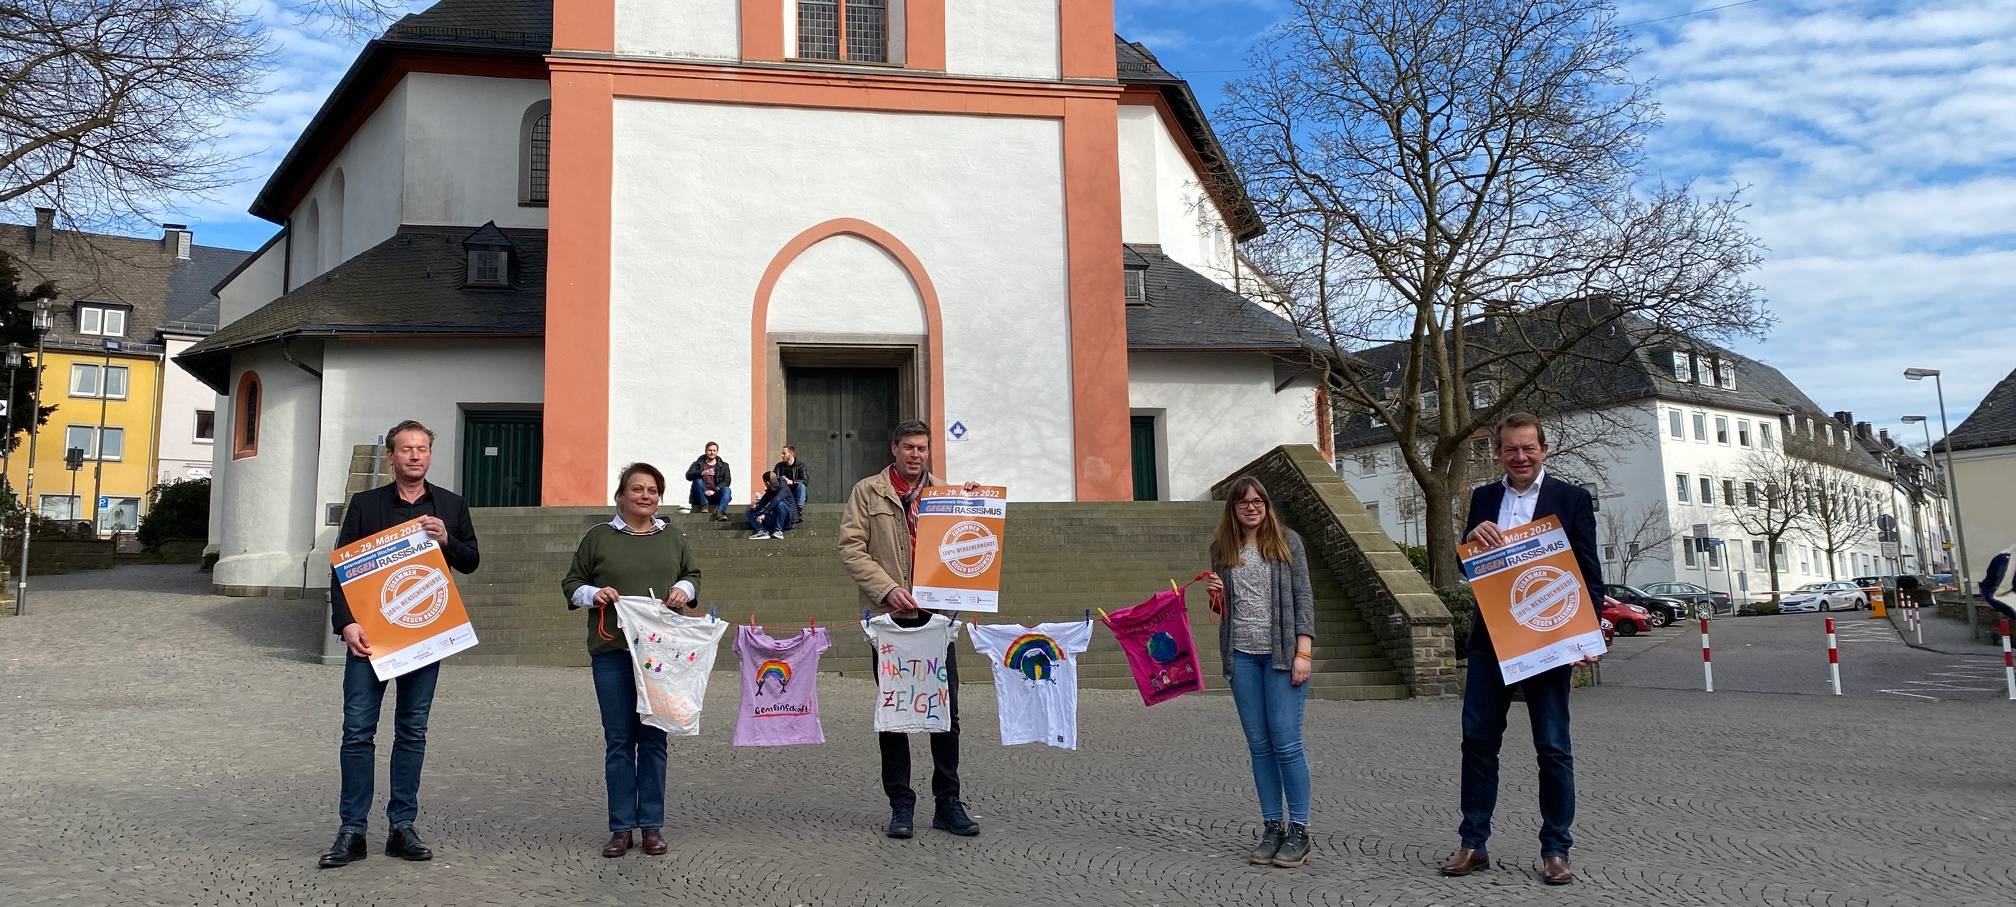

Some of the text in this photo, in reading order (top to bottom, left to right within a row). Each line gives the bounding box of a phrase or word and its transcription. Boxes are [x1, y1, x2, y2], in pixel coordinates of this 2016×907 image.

[946, 489, 957, 497] 29.
[980, 489, 999, 497] 2022
[926, 504, 1002, 516] GEGEN RASSISMUS
[340, 550, 353, 561] 14.
[360, 541, 375, 553] 29.
[375, 533, 399, 547] März
[400, 523, 422, 537] 2022
[1467, 546, 1481, 557] 14.
[1504, 530, 1529, 545] März
[1530, 522, 1553, 536] 2022
[345, 539, 434, 579] GEGEN RASSISMUS
[1473, 557, 1505, 576] GEGEN
[1507, 540, 1565, 567] RASSISMUS
[387, 569, 417, 592] ZUSAMMEN
[1517, 570, 1547, 593] ZUSAMMEN
[401, 614, 423, 624] GEGEN
[1531, 618, 1553, 627] GEGEN
[880, 644, 893, 655] #
[881, 657, 947, 683] HALTUNG
[883, 685, 948, 720] ZEIGEN
